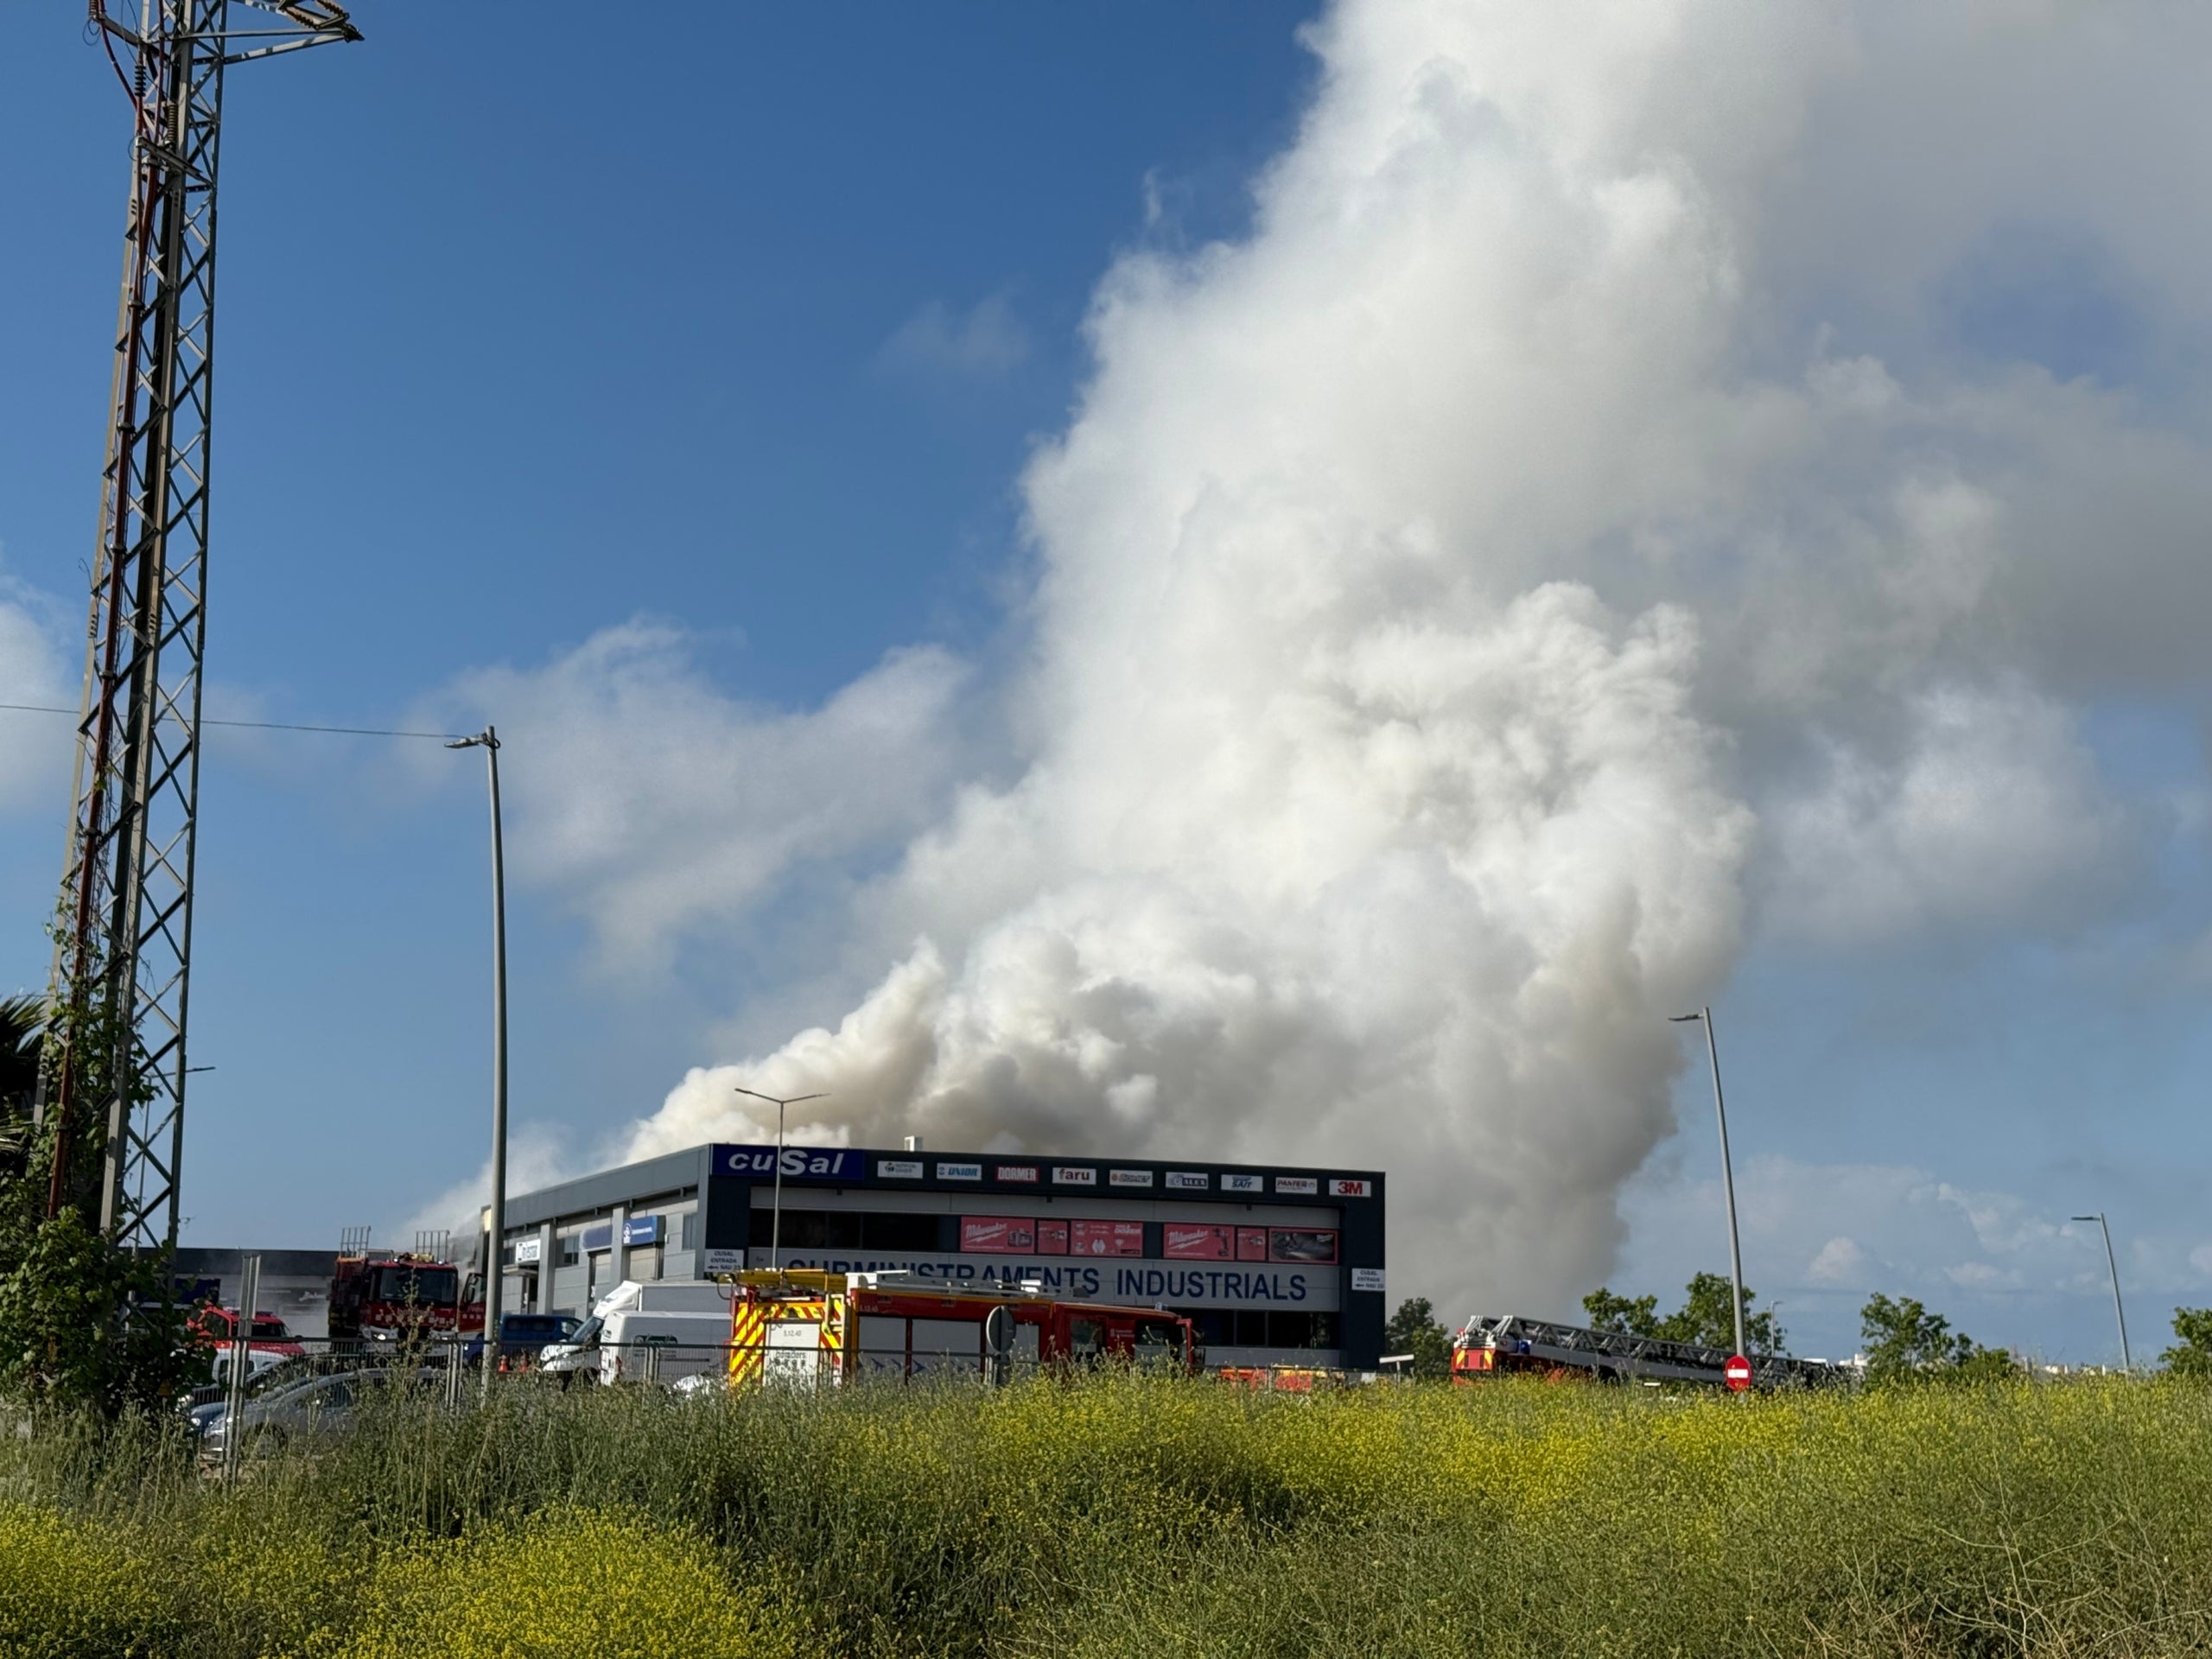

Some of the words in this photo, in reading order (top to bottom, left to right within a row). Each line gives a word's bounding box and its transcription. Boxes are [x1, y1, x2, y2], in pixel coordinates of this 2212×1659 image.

[728, 1149, 845, 1176] cuSal
[997, 1166, 1037, 1181] DORMER
[1059, 1168, 1090, 1181] faru
[1338, 1181, 1363, 1195] 3M
[1117, 1268, 1306, 1300] INDUSTRIALS
